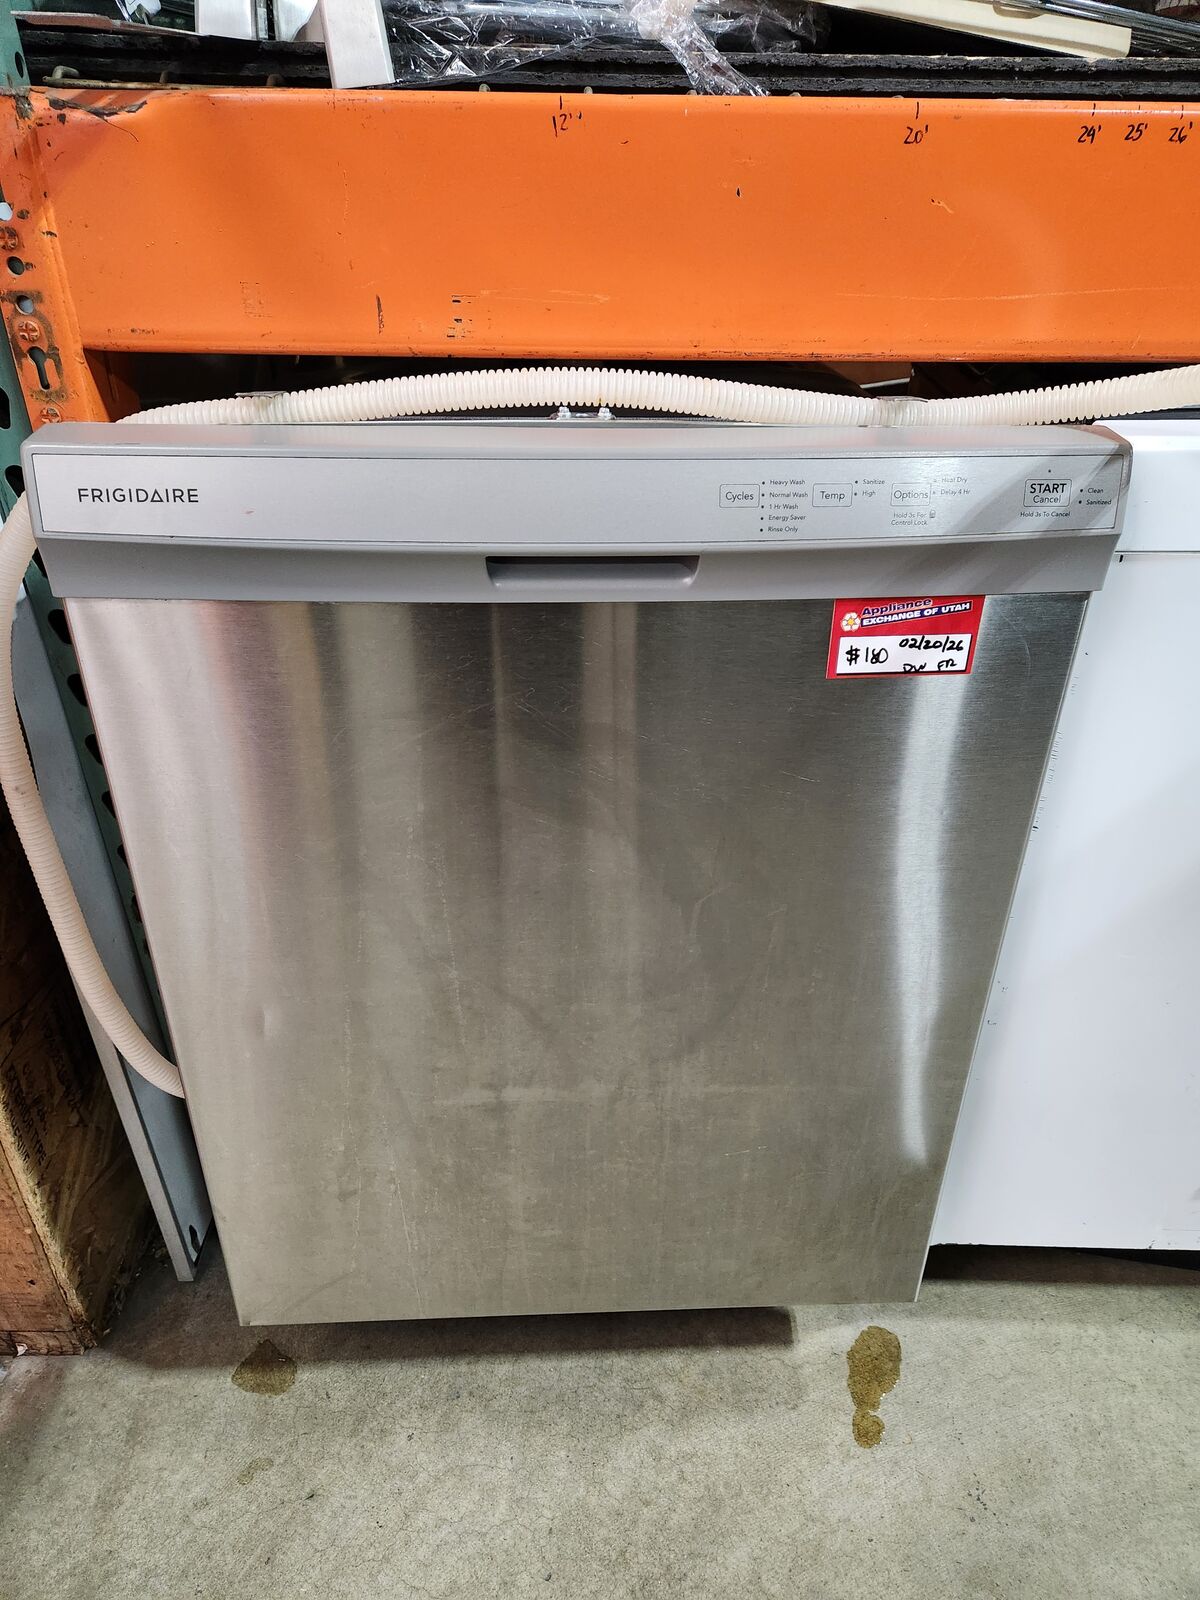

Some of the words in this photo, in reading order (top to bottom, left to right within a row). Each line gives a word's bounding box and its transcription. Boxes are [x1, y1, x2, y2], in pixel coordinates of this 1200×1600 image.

[1029, 483, 1067, 494] START
[77, 488, 199, 503] FRIGIDAIRE
[725, 491, 754, 502] Cycles
[820, 490, 846, 502] Temp
[893, 490, 929, 501] Options
[1032, 495, 1062, 504] Cancel
[862, 598, 933, 617] Appliance
[862, 610, 922, 627] EXCHANGE
[925, 607, 939, 616] OF
[942, 602, 971, 613] UTAH
[899, 635, 964, 653] 02/20/26
